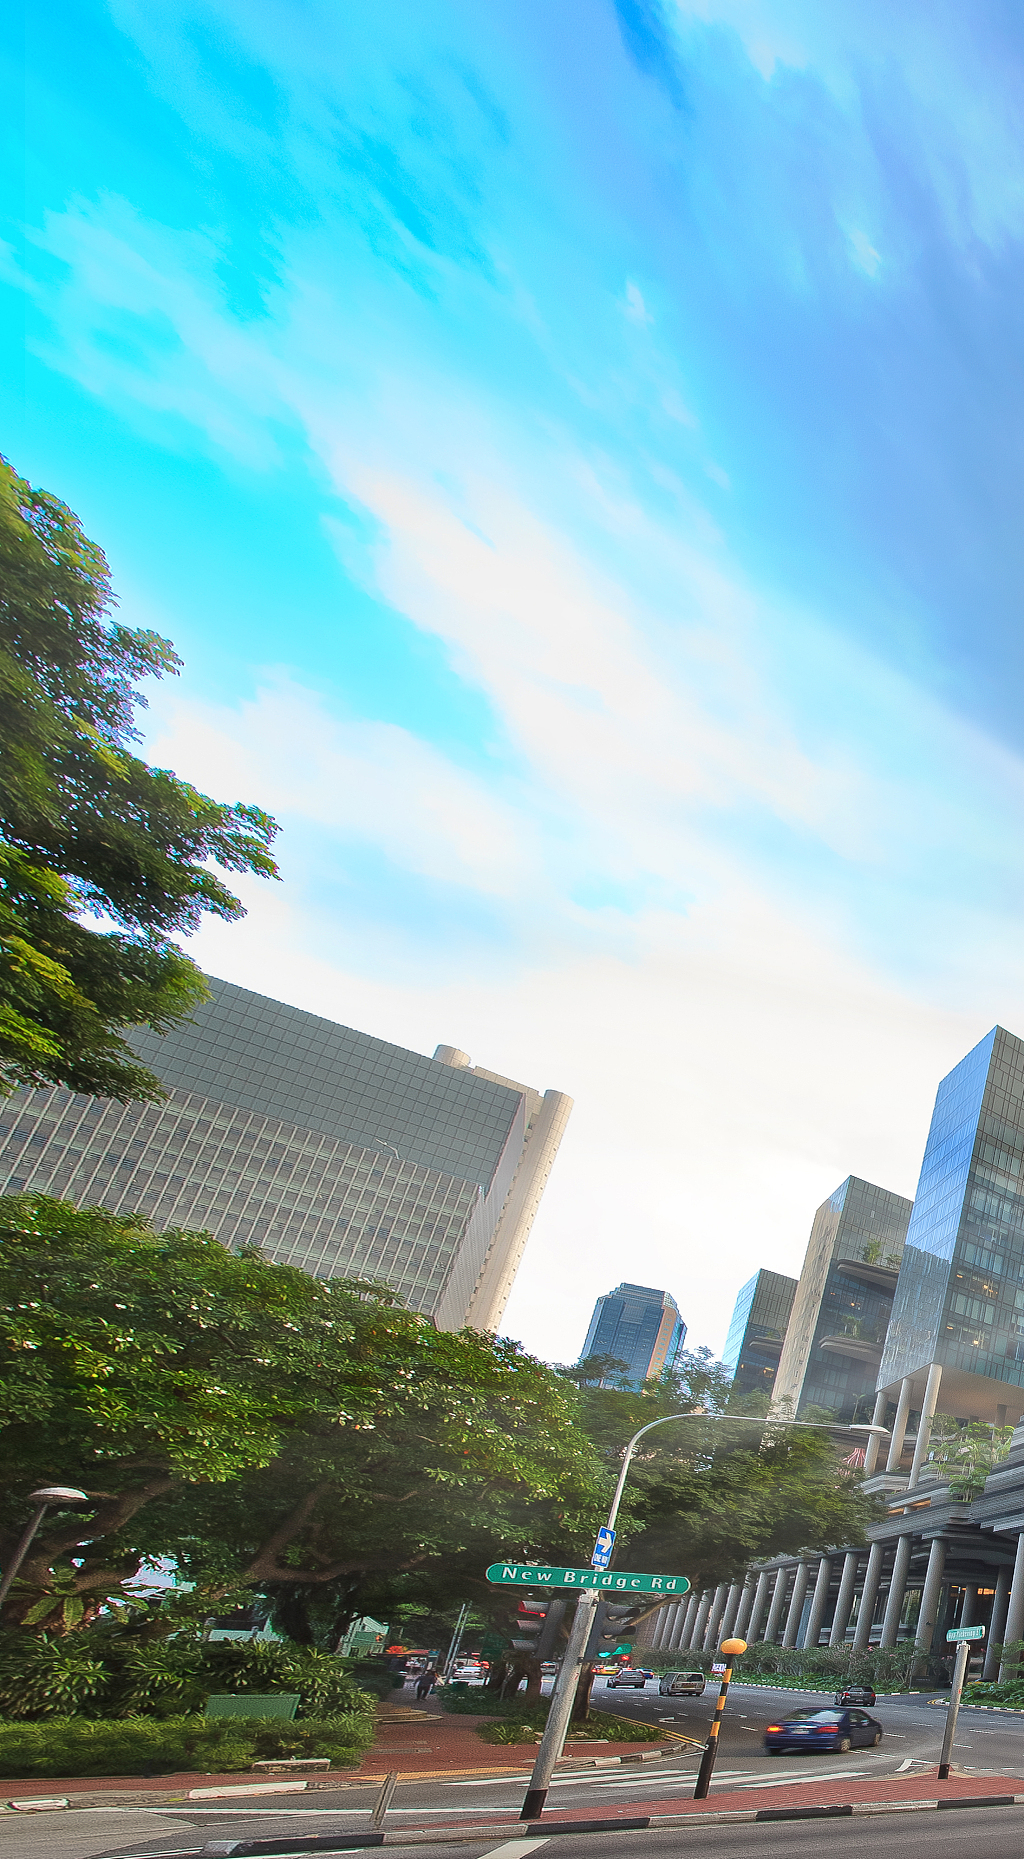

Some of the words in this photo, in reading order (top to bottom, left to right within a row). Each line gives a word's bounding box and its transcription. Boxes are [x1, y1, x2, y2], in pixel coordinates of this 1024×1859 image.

[502, 1567, 552, 1581] New
[563, 1571, 641, 1589] Bridge
[651, 1578, 677, 1590] Rd
